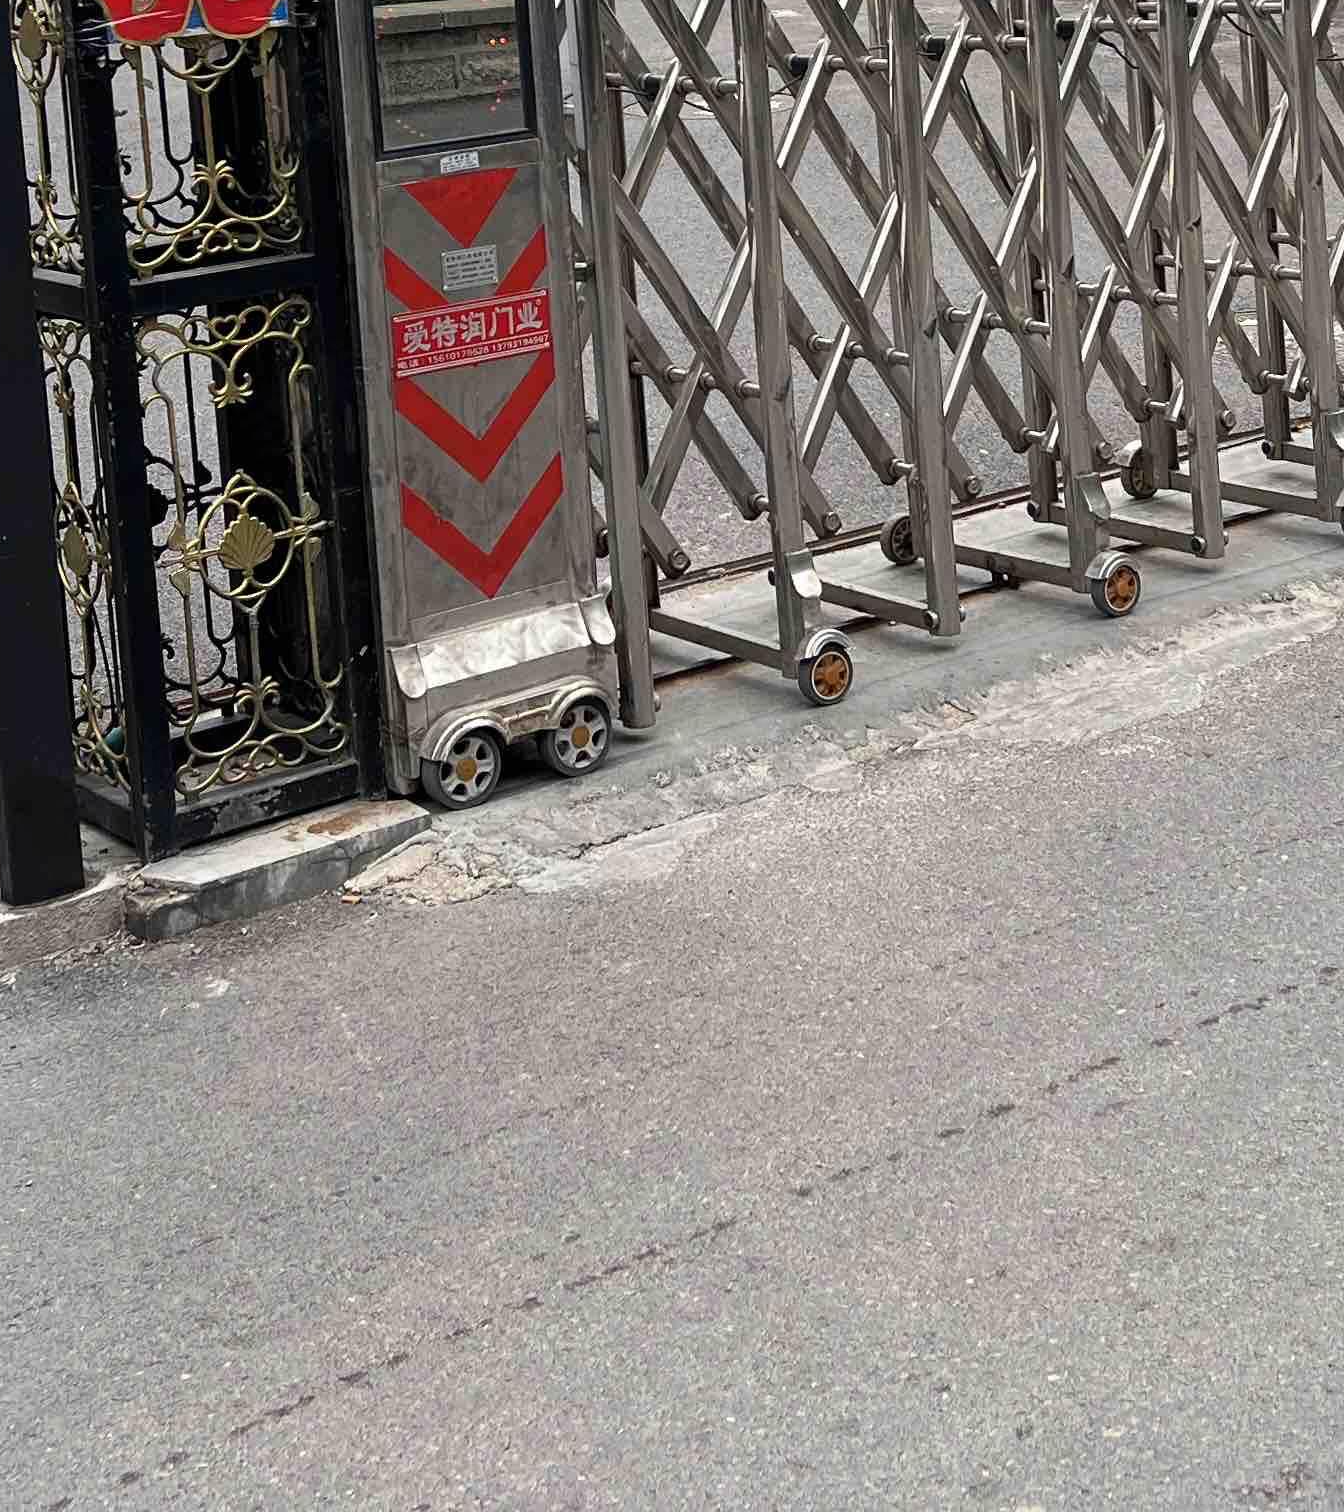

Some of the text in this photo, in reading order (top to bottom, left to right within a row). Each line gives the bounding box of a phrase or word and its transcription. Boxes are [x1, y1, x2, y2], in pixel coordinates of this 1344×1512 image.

[402, 301, 543, 353] 爱特润门业
